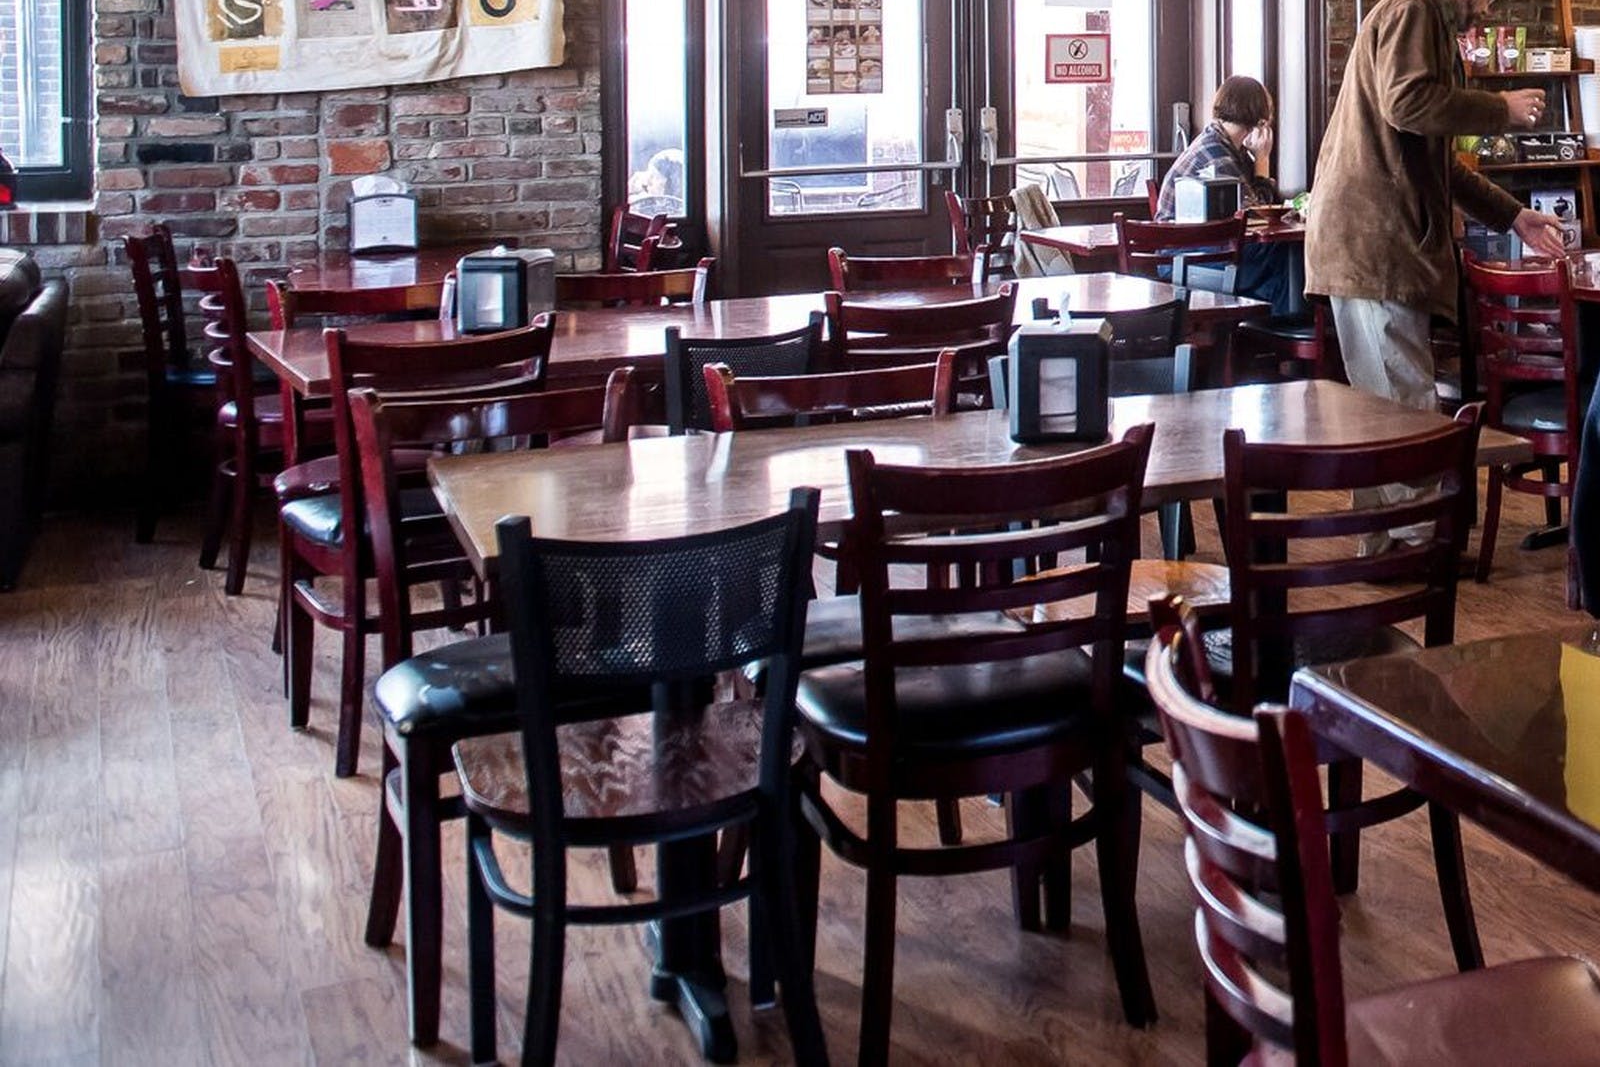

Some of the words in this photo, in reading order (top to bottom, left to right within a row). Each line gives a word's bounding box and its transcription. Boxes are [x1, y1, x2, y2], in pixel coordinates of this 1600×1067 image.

[1056, 65, 1067, 76] NO
[1068, 65, 1101, 76] ALCOHOL
[808, 111, 826, 123] ADT
